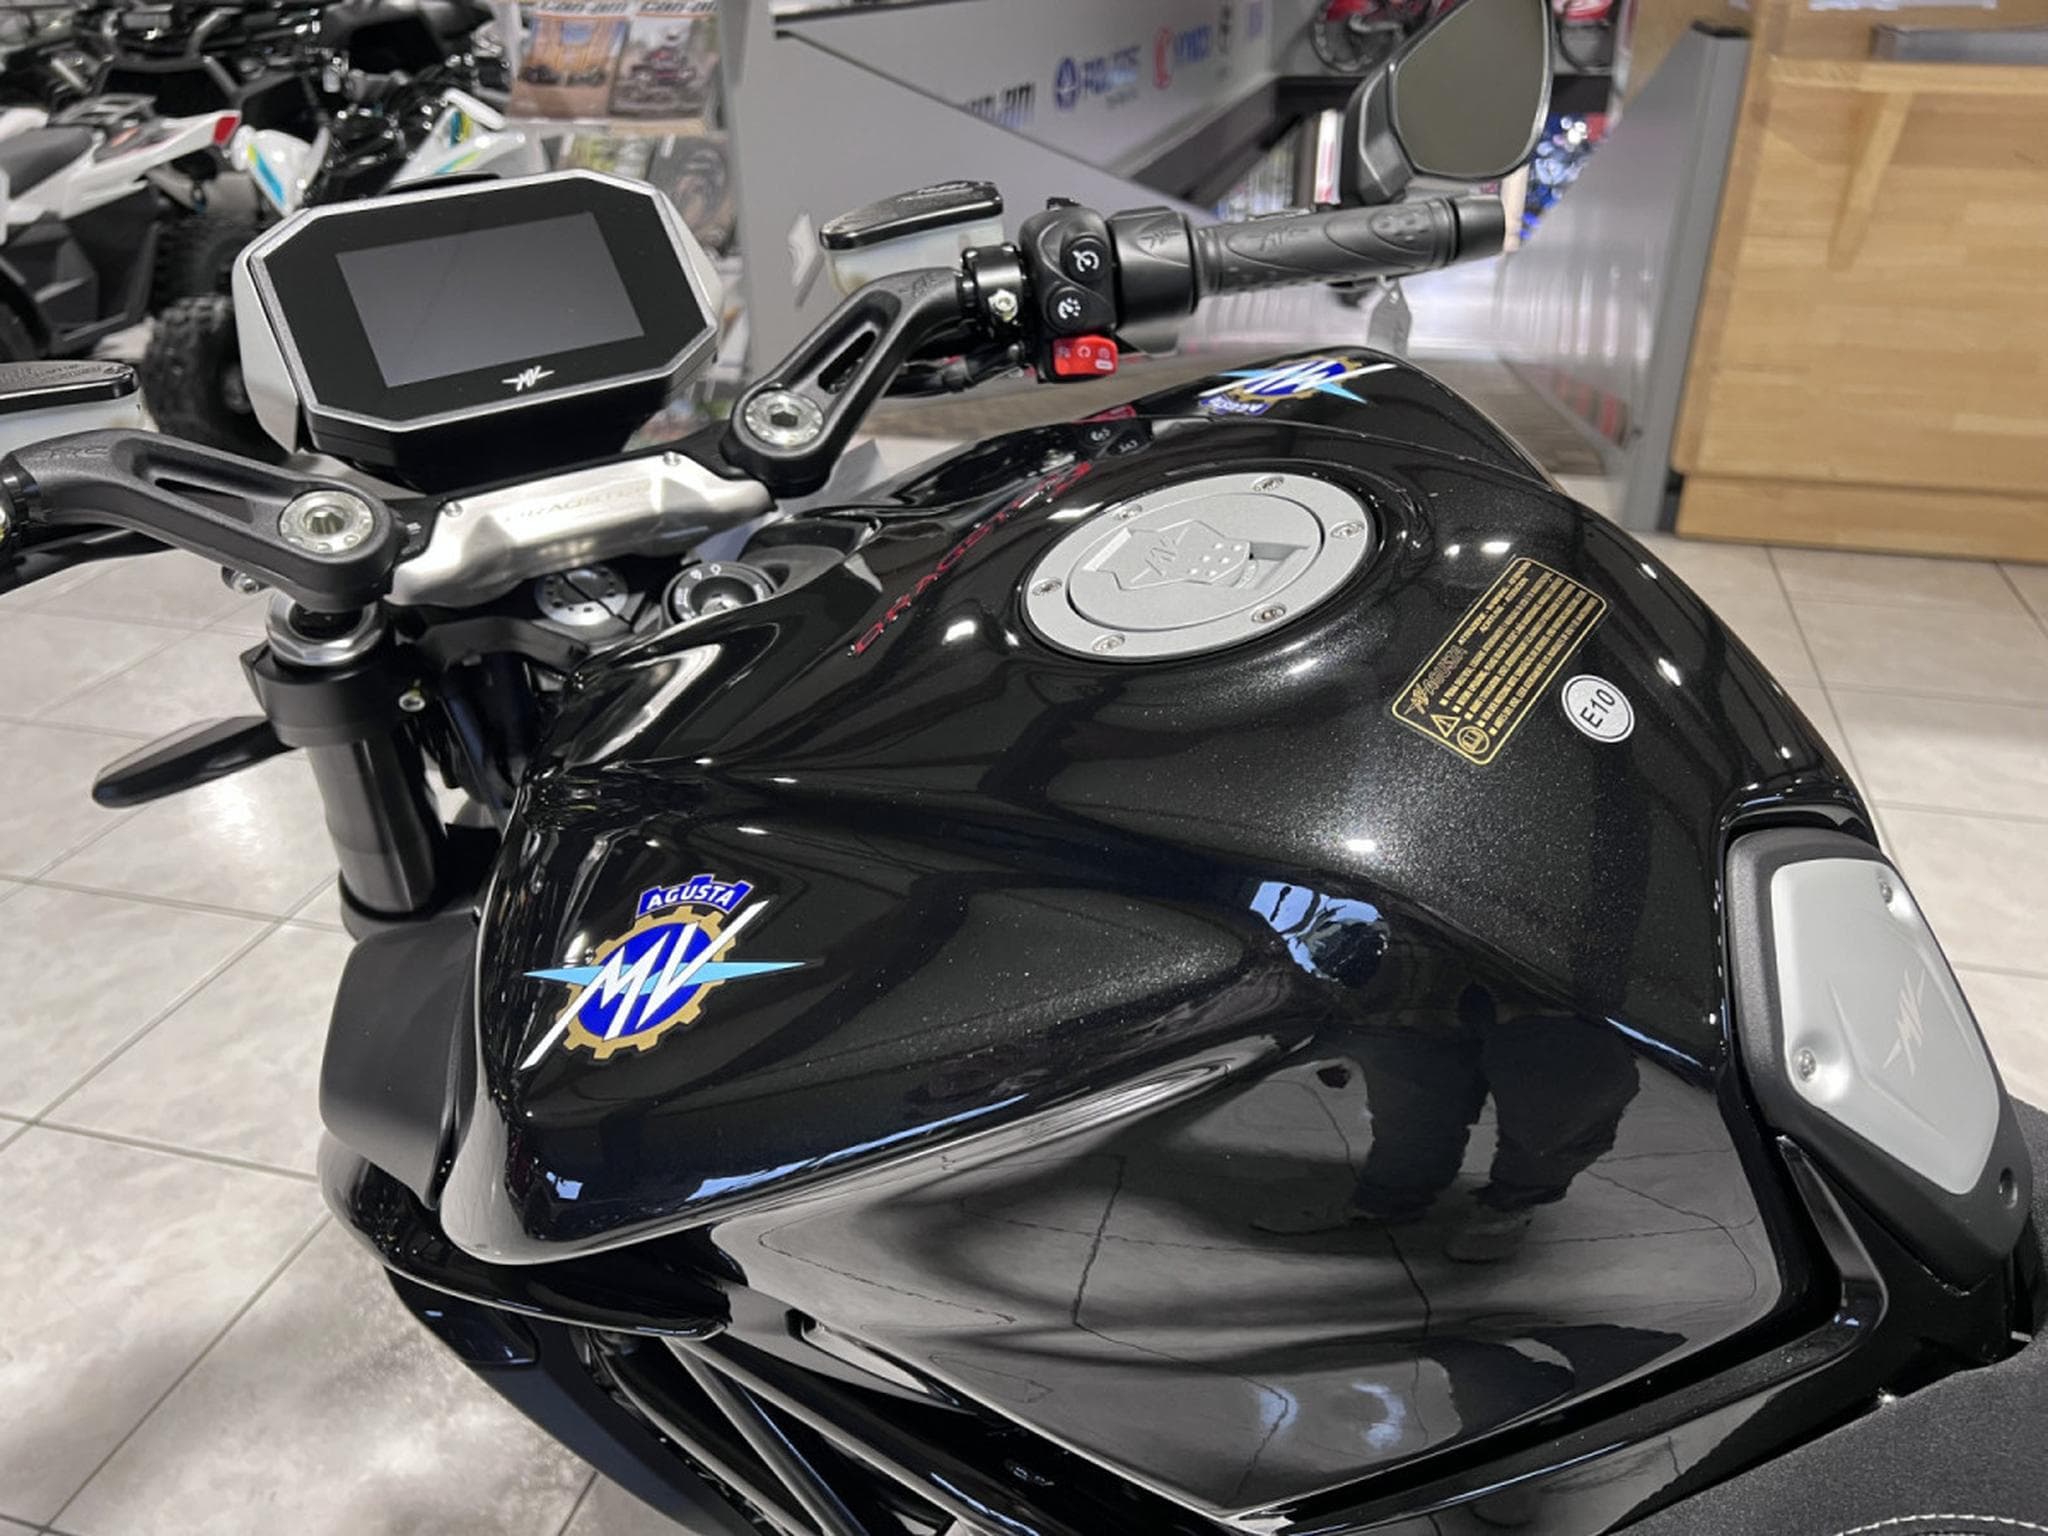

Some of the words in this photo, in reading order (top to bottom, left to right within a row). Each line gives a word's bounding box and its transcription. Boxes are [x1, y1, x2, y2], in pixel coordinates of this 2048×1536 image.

[1580, 688, 1616, 729] E10
[646, 884, 736, 910] AGUSTA
[520, 899, 771, 1071] MV
